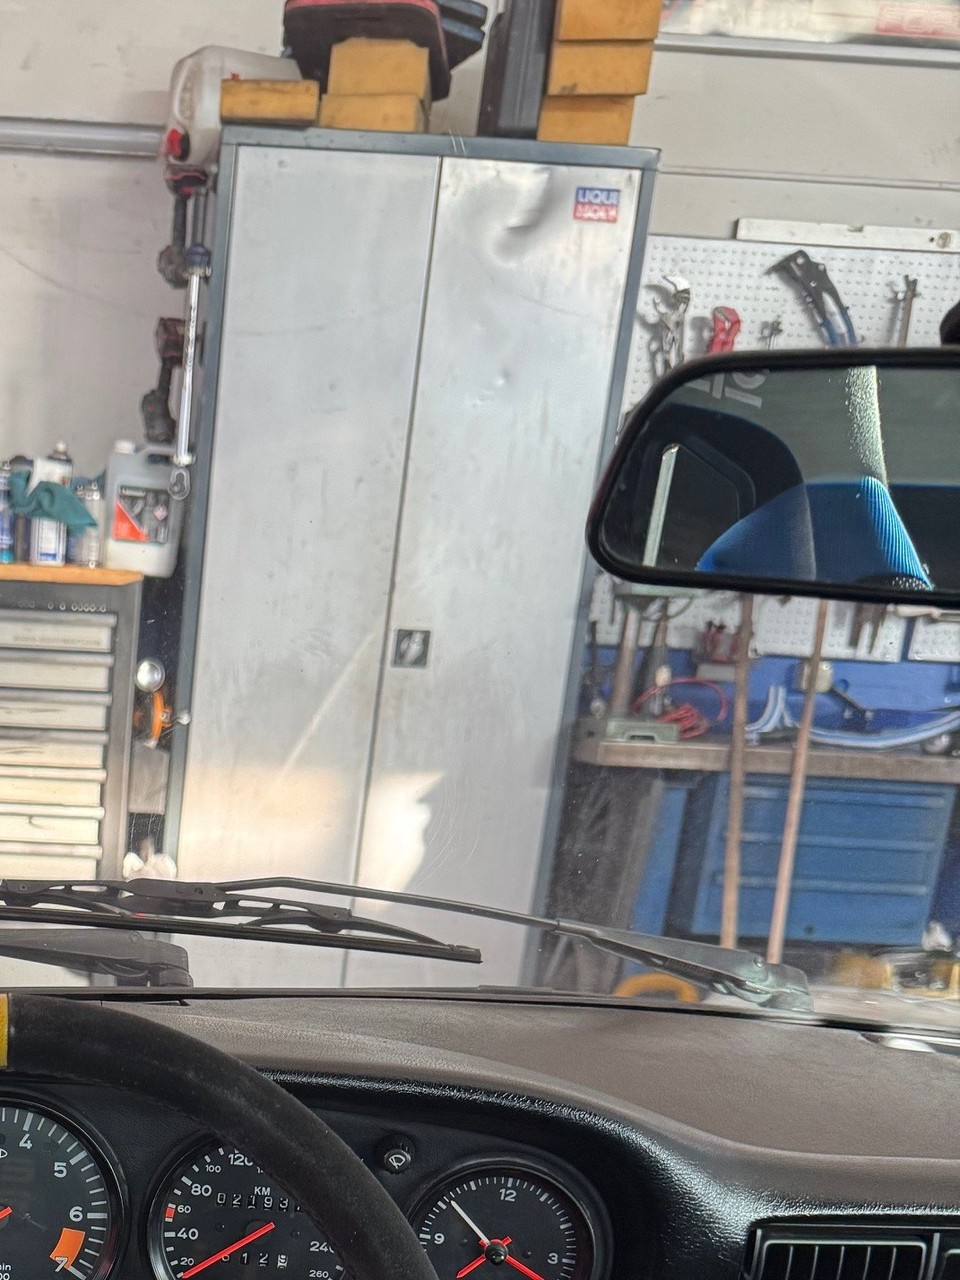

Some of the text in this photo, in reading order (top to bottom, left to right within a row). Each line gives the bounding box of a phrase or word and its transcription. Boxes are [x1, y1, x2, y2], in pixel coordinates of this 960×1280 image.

[578, 189, 619, 205] LIQUI
[19, 1133, 33, 1149] 4
[54, 1161, 67, 1178] 5
[205, 1164, 222, 1173] 100
[191, 1184, 212, 1197] 80
[254, 1186, 271, 1196] KM
[499, 1188, 517, 1202] 12
[69, 1206, 83, 1222] 6
[177, 1205, 192, 1214] 60
[177, 1228, 199, 1240] 40
[434, 1232, 445, 1245] 9
[54, 1256, 68, 1272] 7
[180, 1257, 195, 1266] 20
[547, 1253, 559, 1265] 3
[309, 1270, 329, 1278] 260
